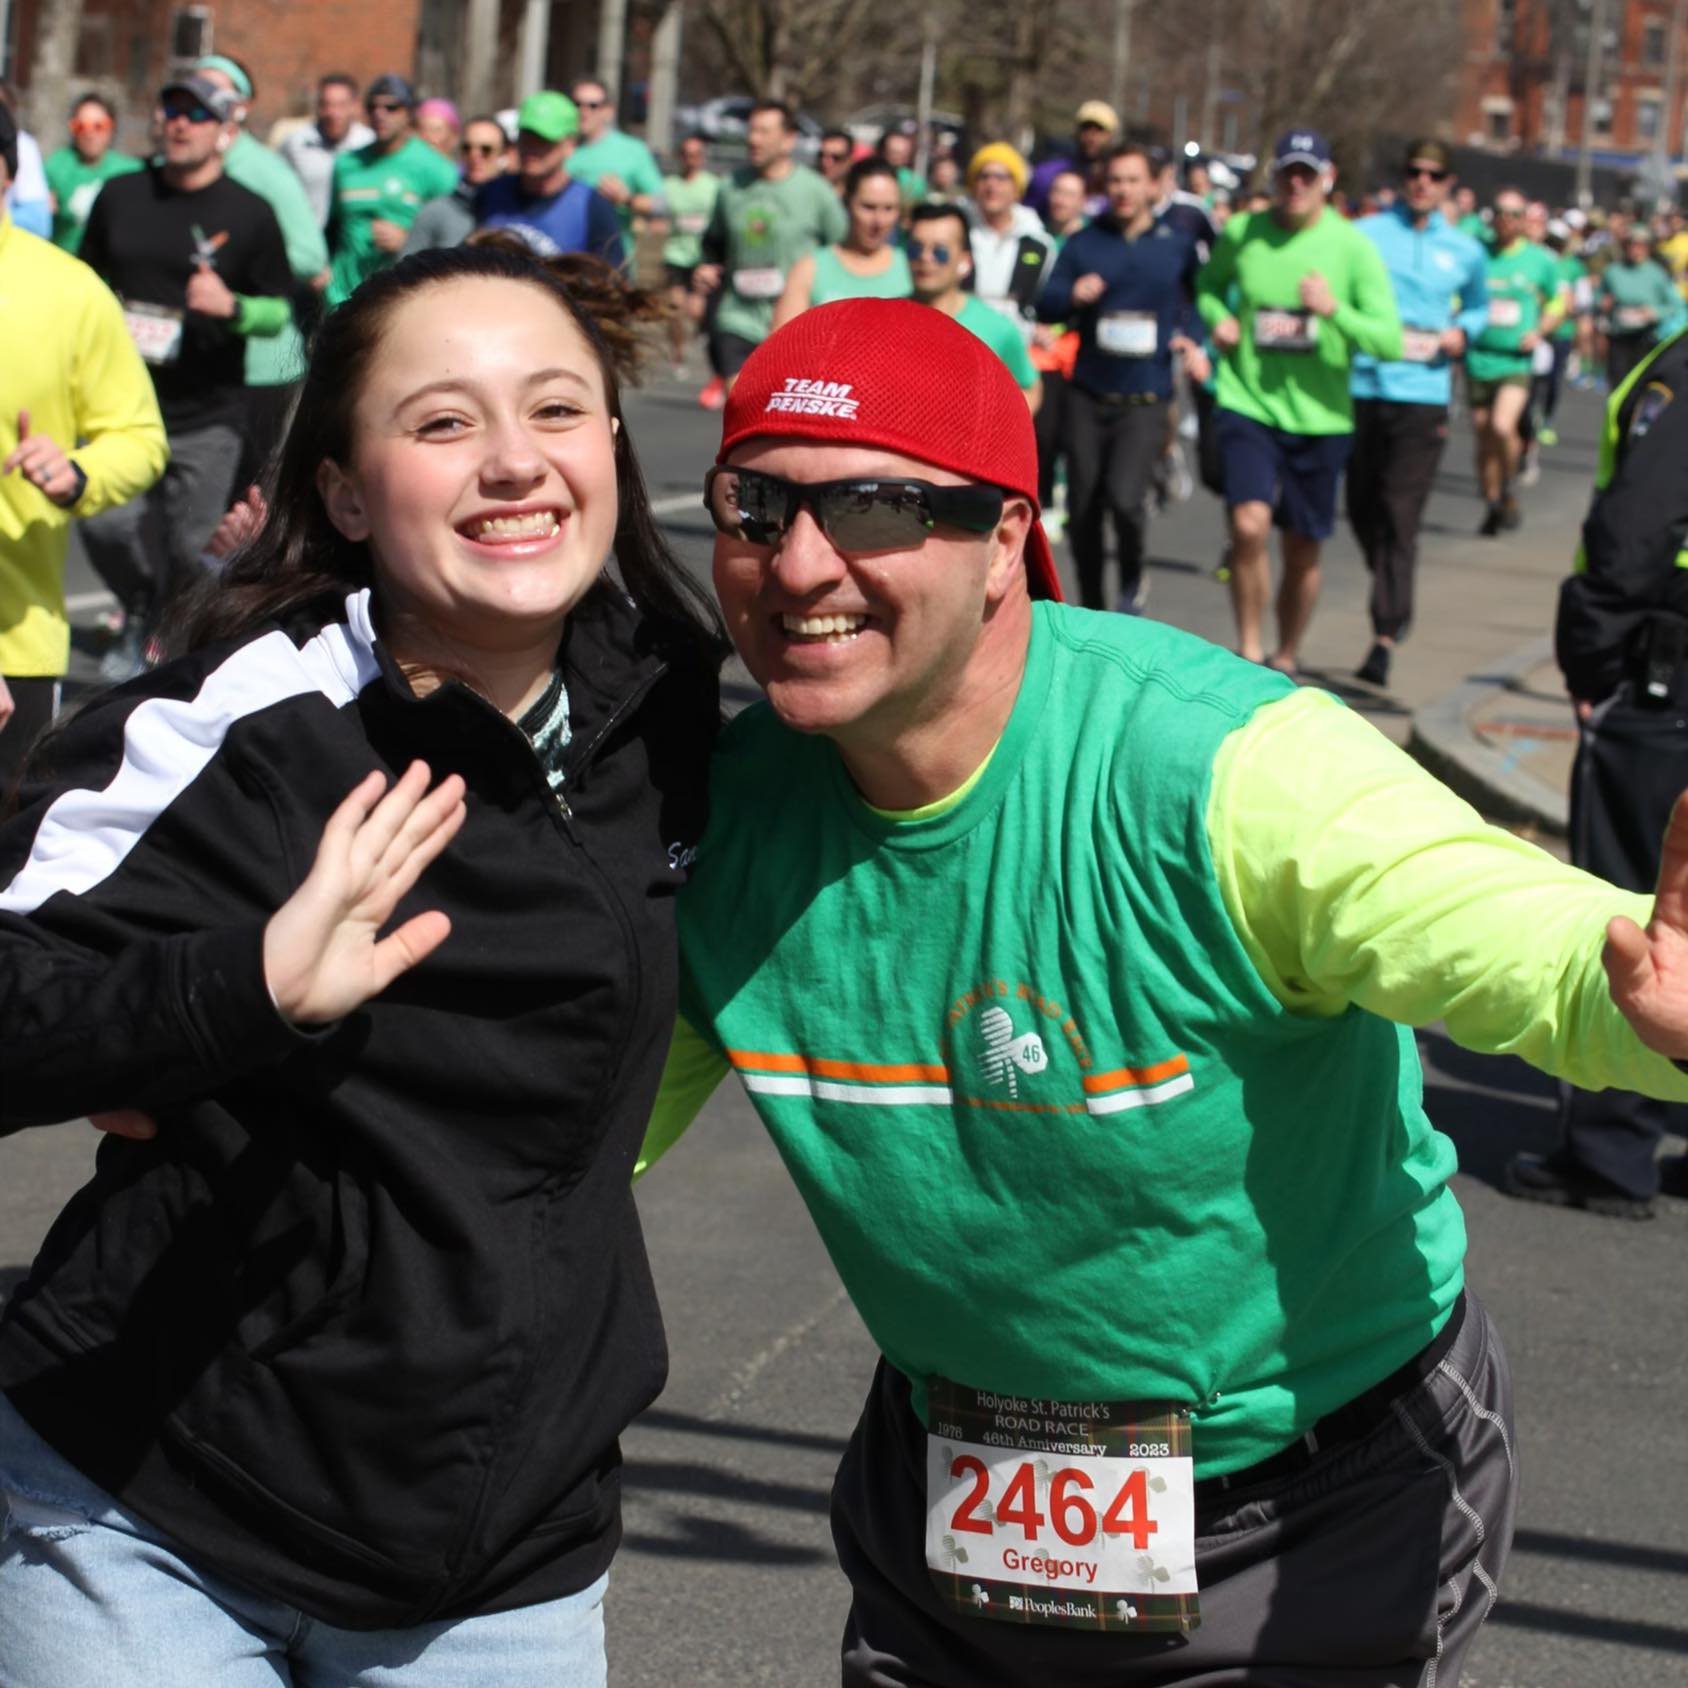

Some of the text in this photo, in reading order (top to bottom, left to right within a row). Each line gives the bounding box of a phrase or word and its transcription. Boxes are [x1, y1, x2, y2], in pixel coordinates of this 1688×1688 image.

[784, 378, 853, 397] TEAM
[765, 397, 857, 418] PENSKE
[1022, 1044, 1041, 1062] 46
[977, 1391, 1110, 1419] Holyoke St. Patrick's
[995, 1414, 1089, 1437] ROAD RACE
[937, 1422, 1170, 1457] 1976 46th Anniversary 2023
[951, 1454, 1158, 1550] 2464
[1003, 1548, 1098, 1583] Gregory
[1024, 1597, 1097, 1619] PeoplesBank
